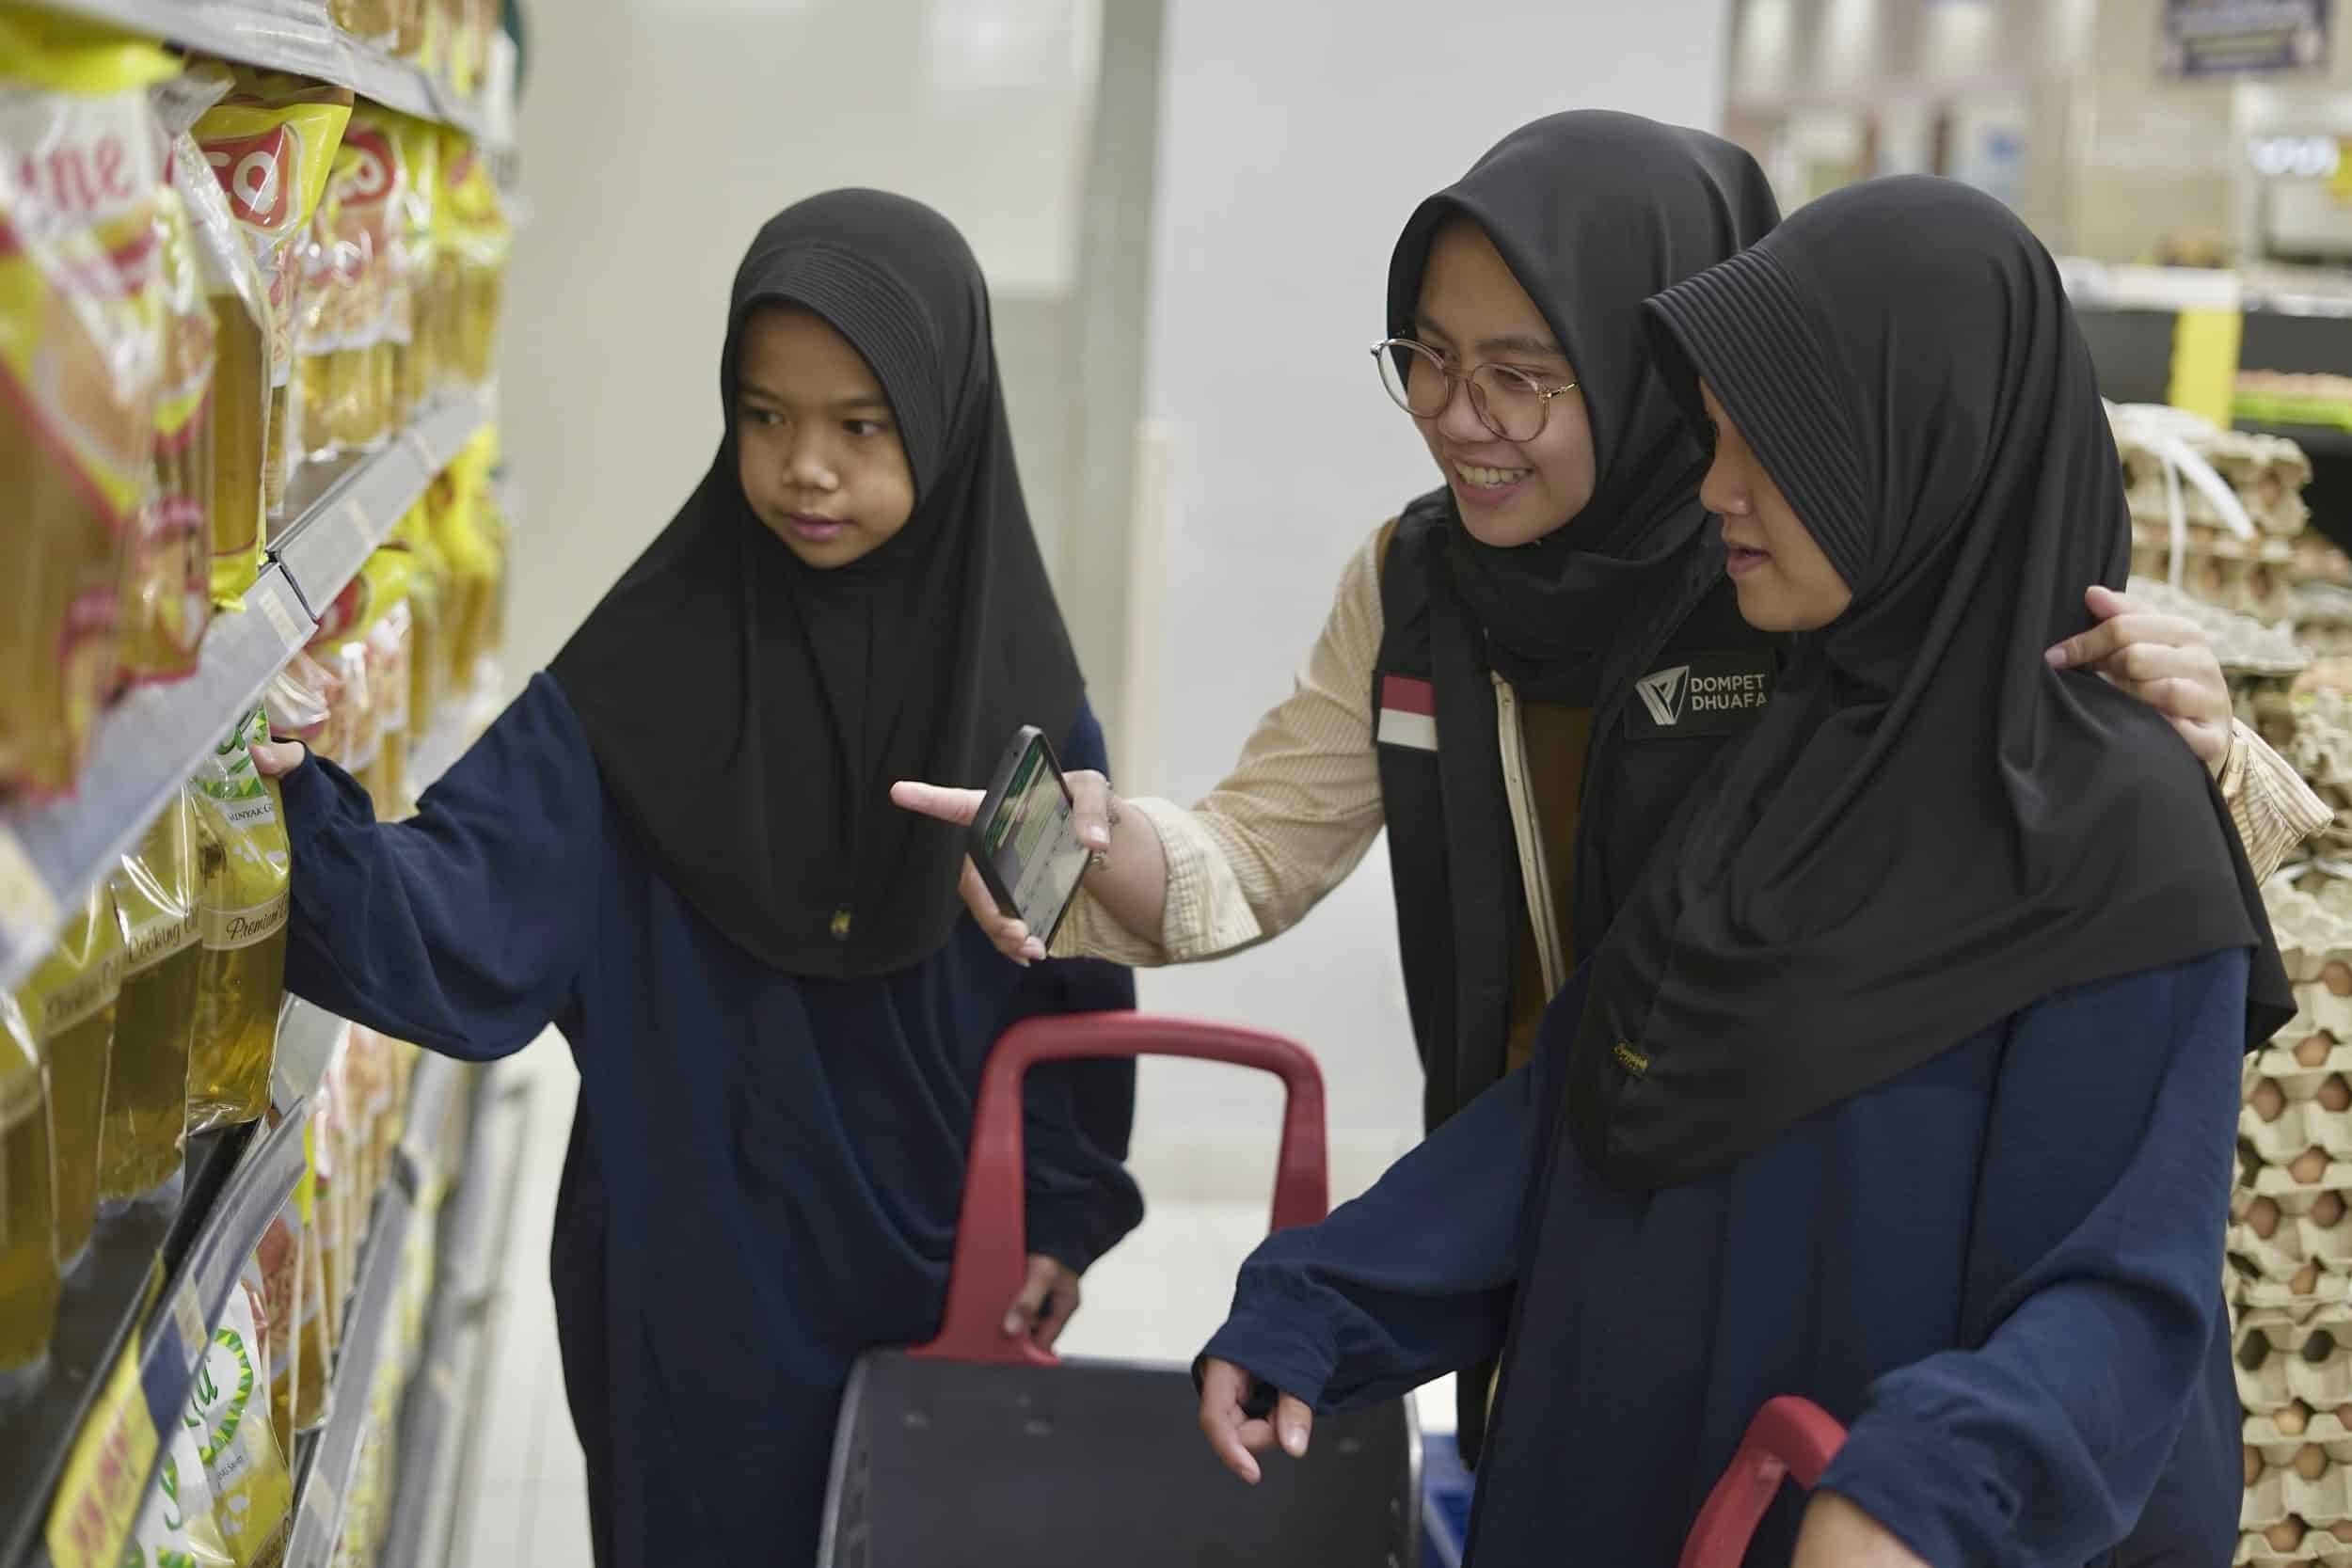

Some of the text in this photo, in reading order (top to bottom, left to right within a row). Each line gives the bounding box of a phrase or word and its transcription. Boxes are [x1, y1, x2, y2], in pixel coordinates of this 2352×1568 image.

[1691, 673, 1766, 693] DOMPET
[1692, 691, 1768, 711] DHUAFA
[226, 912, 278, 940] Premium
